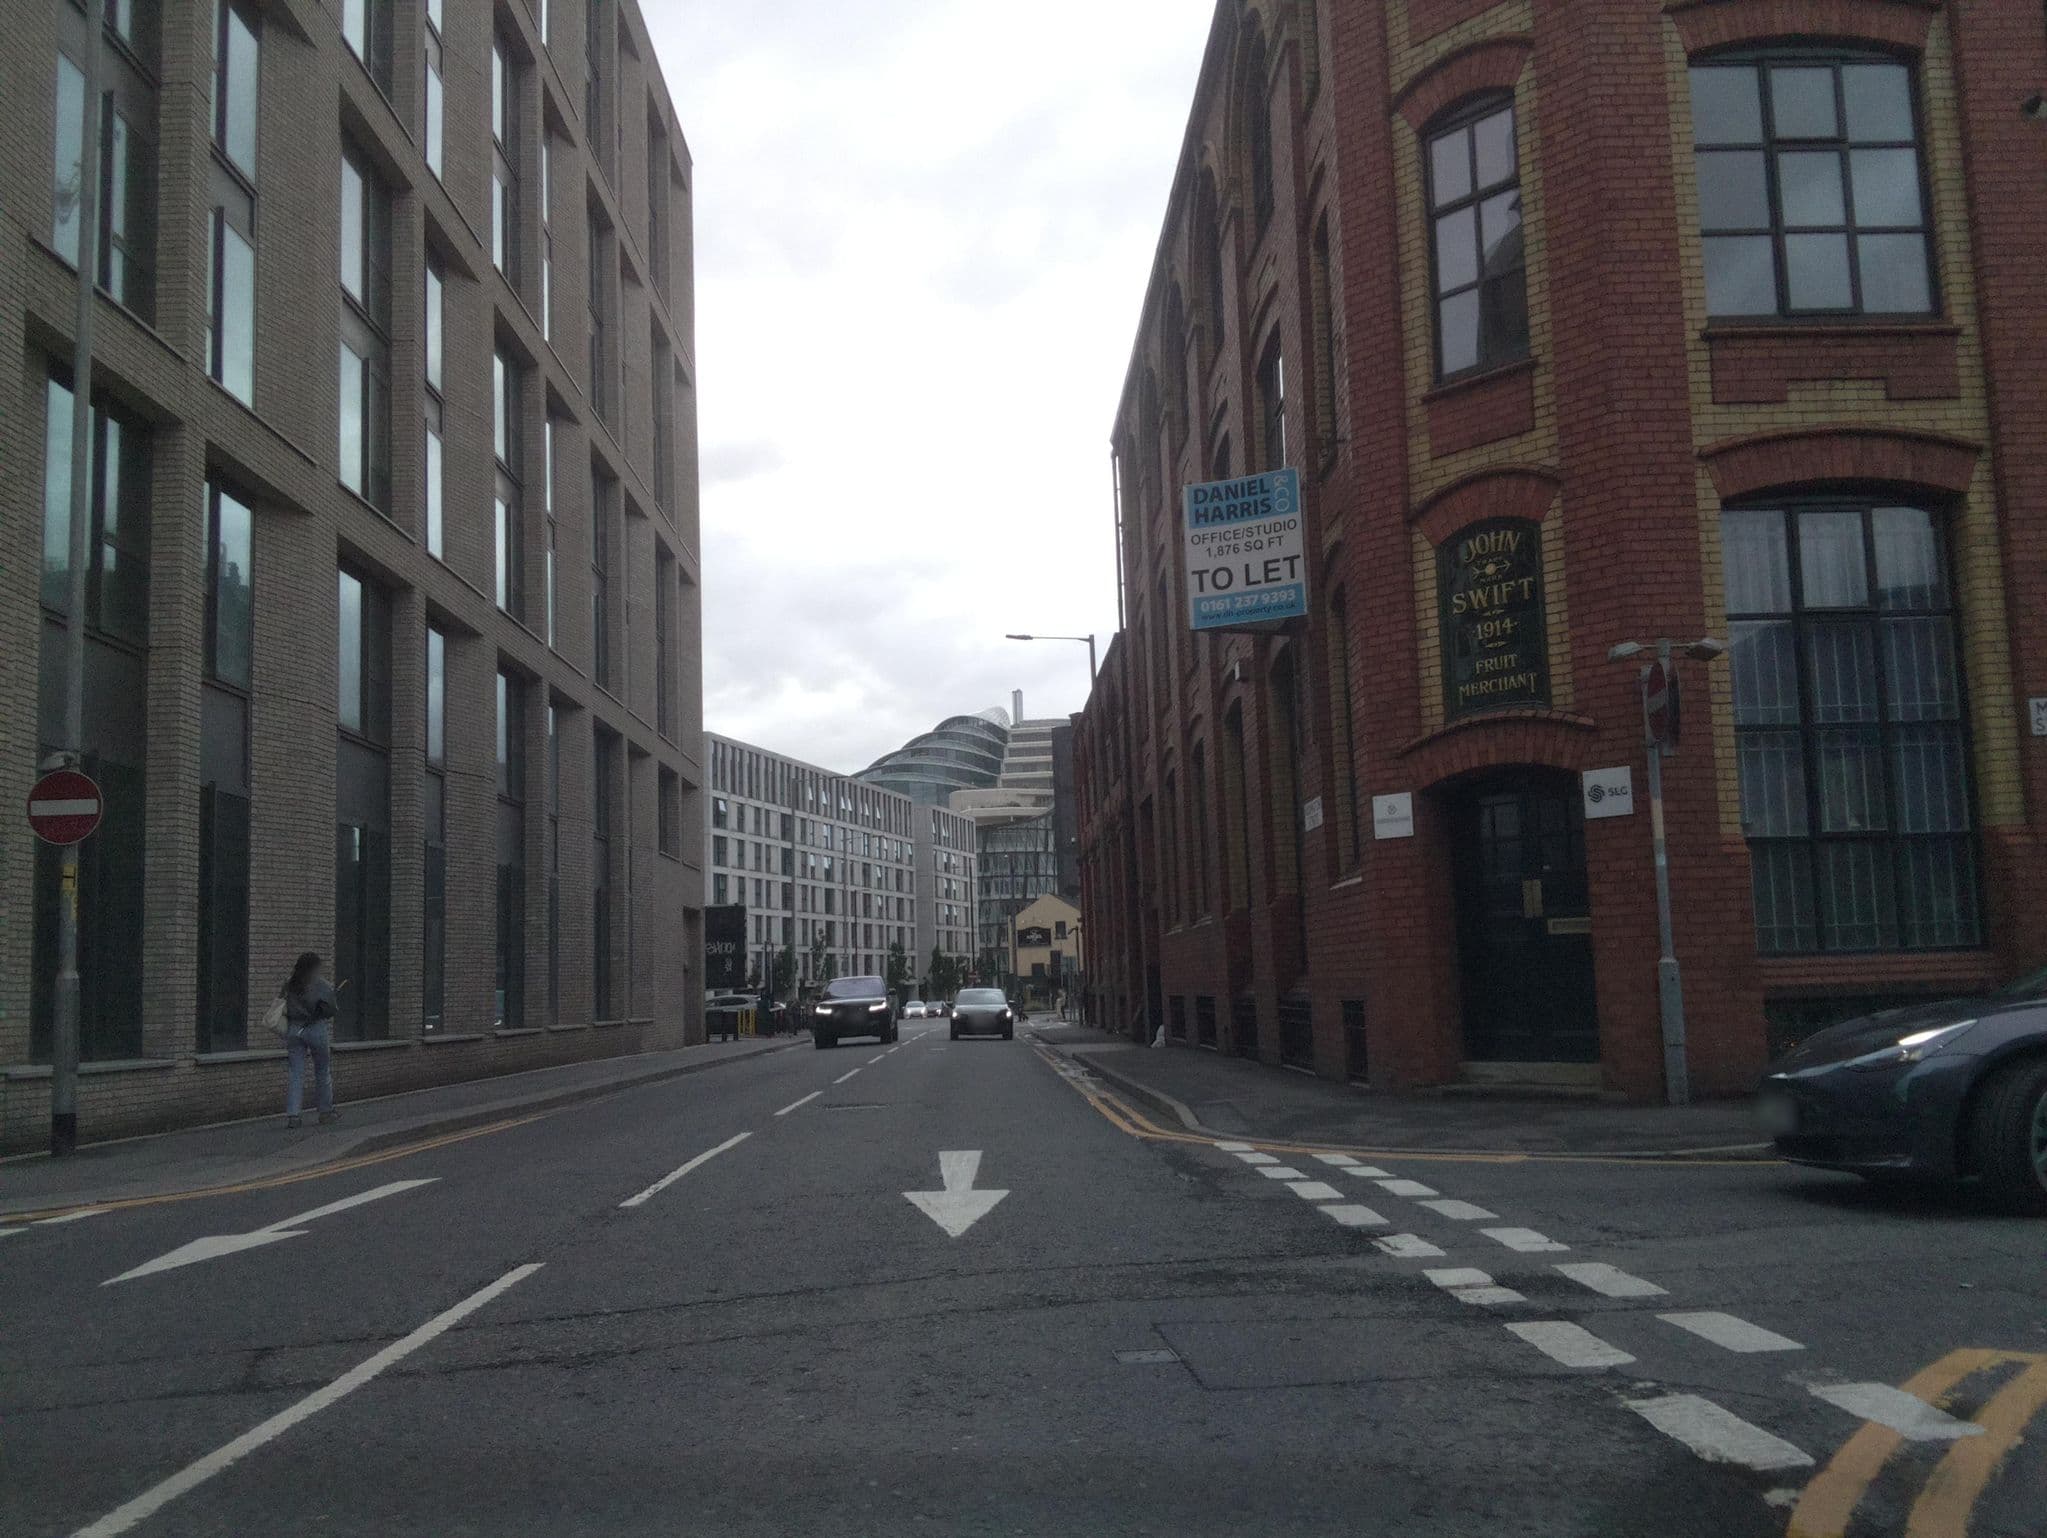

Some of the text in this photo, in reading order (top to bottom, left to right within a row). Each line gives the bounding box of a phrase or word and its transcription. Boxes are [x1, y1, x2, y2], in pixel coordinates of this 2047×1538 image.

[1193, 478, 1271, 505] DANIEL
[1194, 498, 1272, 524] HARRIS
[1191, 519, 1297, 546] OFFICE/STUDIO
[1206, 535, 1284, 559] 1,876 SQ FT
[1465, 530, 1521, 563] JOHN
[1192, 554, 1301, 593] TO LET
[1200, 598, 1231, 612] 0161
[1452, 577, 1535, 615] SWIFT
[1475, 617, 1515, 640] 1914
[1476, 654, 1519, 674] FRUIT
[1458, 672, 1537, 705] MERCHANT
